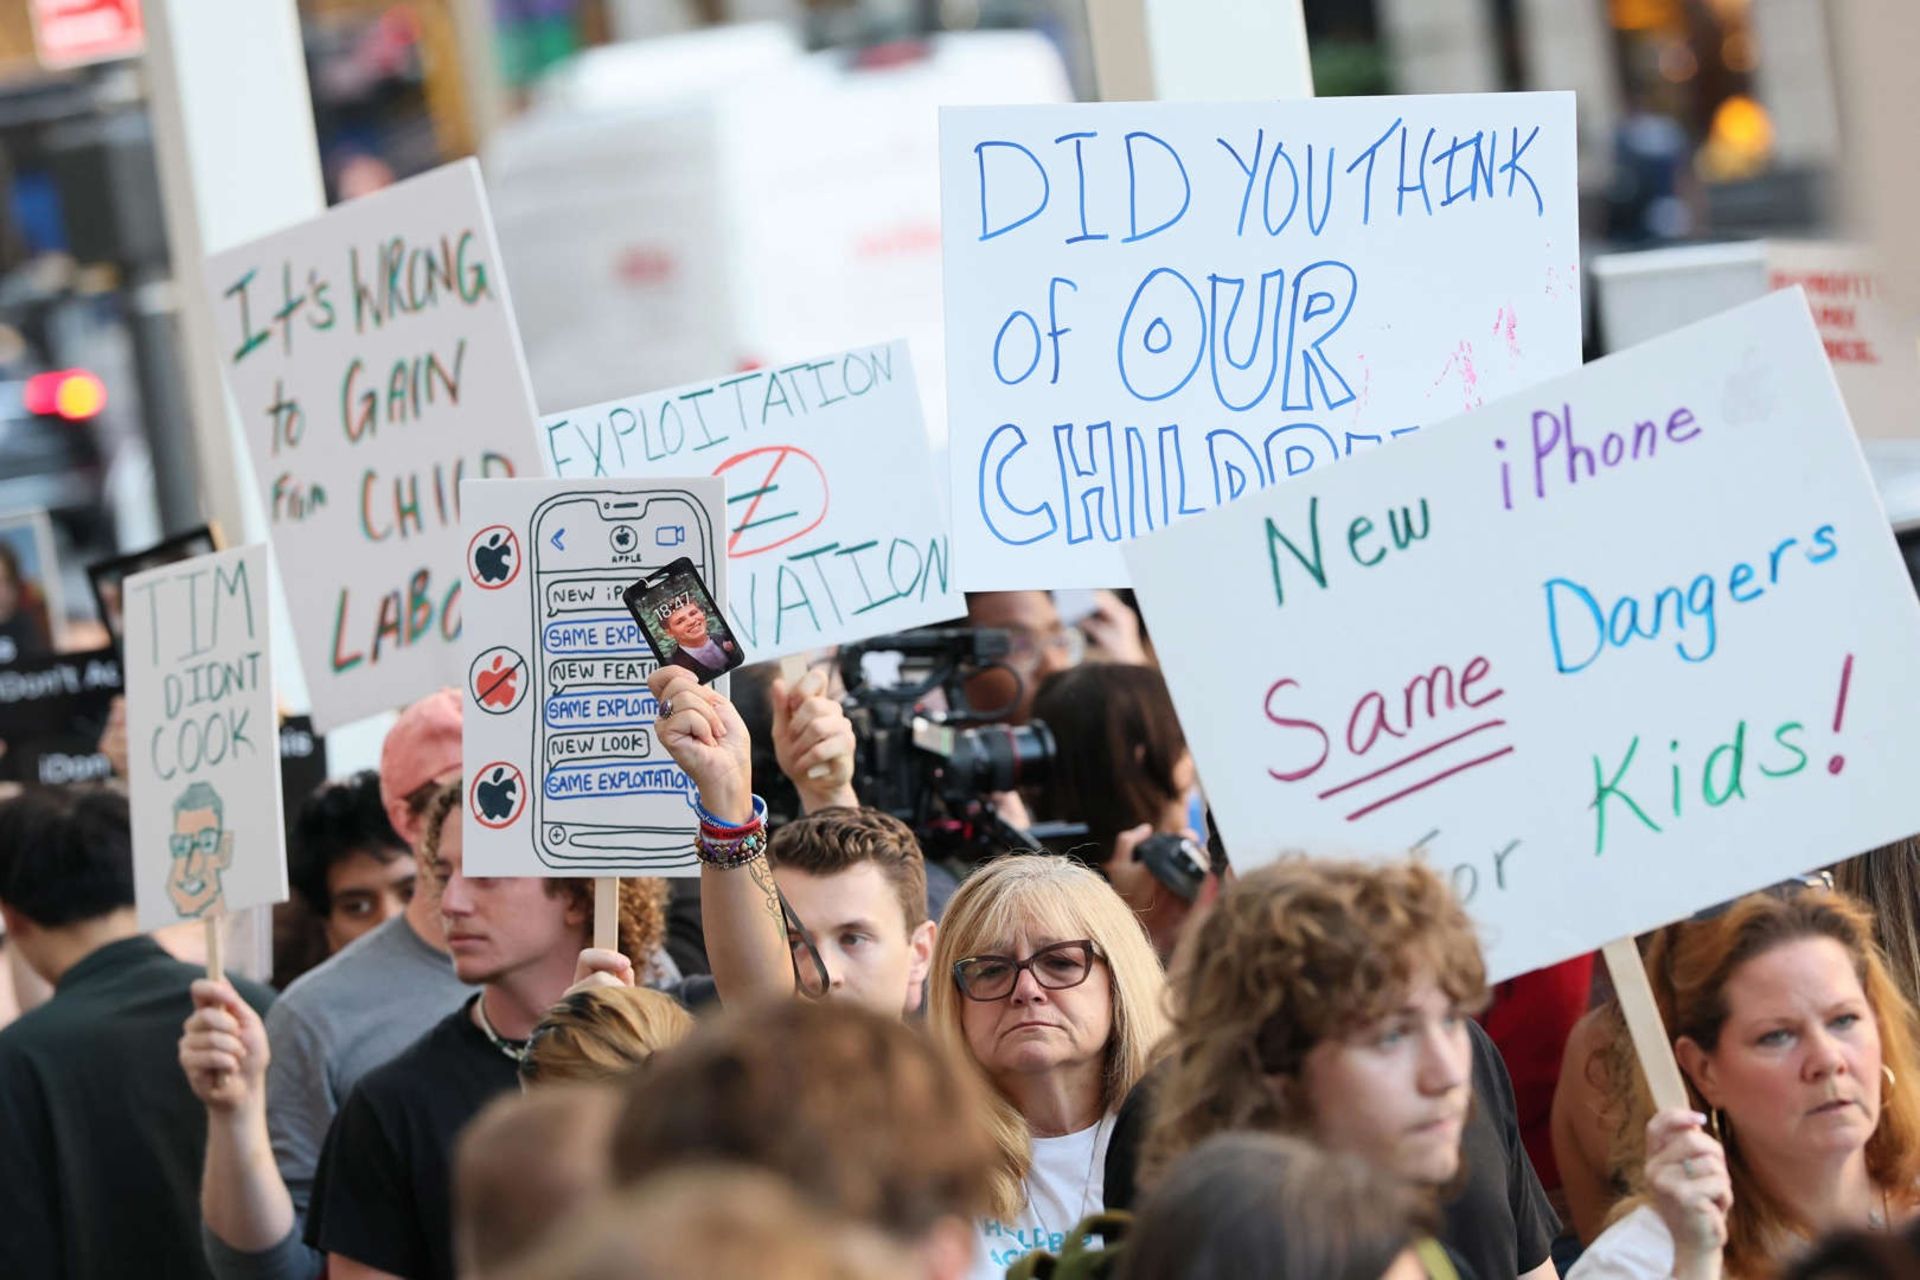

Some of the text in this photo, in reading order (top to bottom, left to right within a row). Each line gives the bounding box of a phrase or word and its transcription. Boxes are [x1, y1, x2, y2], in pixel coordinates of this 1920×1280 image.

[975, 117, 1543, 244] DID YOU THINK
[224, 229, 494, 363] It's WRONG
[1118, 260, 1356, 412] OUR
[342, 338, 466, 443] GAIN
[547, 346, 892, 476] EXPLOITATION
[1264, 404, 1702, 607] New iPhone
[552, 585, 627, 603] NEW iP
[611, 553, 642, 564] APPLE
[653, 591, 691, 621] 18:47
[728, 534, 948, 649] VATION
[131, 560, 255, 667] TIM
[330, 569, 462, 672] LABO
[549, 625, 647, 647] SAME EXPL
[1264, 524, 1838, 782] Same Dangers
[163, 651, 262, 721] DIDNT
[548, 700, 591, 719] SAME
[552, 662, 595, 681] NEW
[151, 707, 256, 780] COOK
[548, 774, 593, 793] SAME
[551, 734, 644, 755] NEW LOOK
[1588, 654, 1854, 856] Kids!
